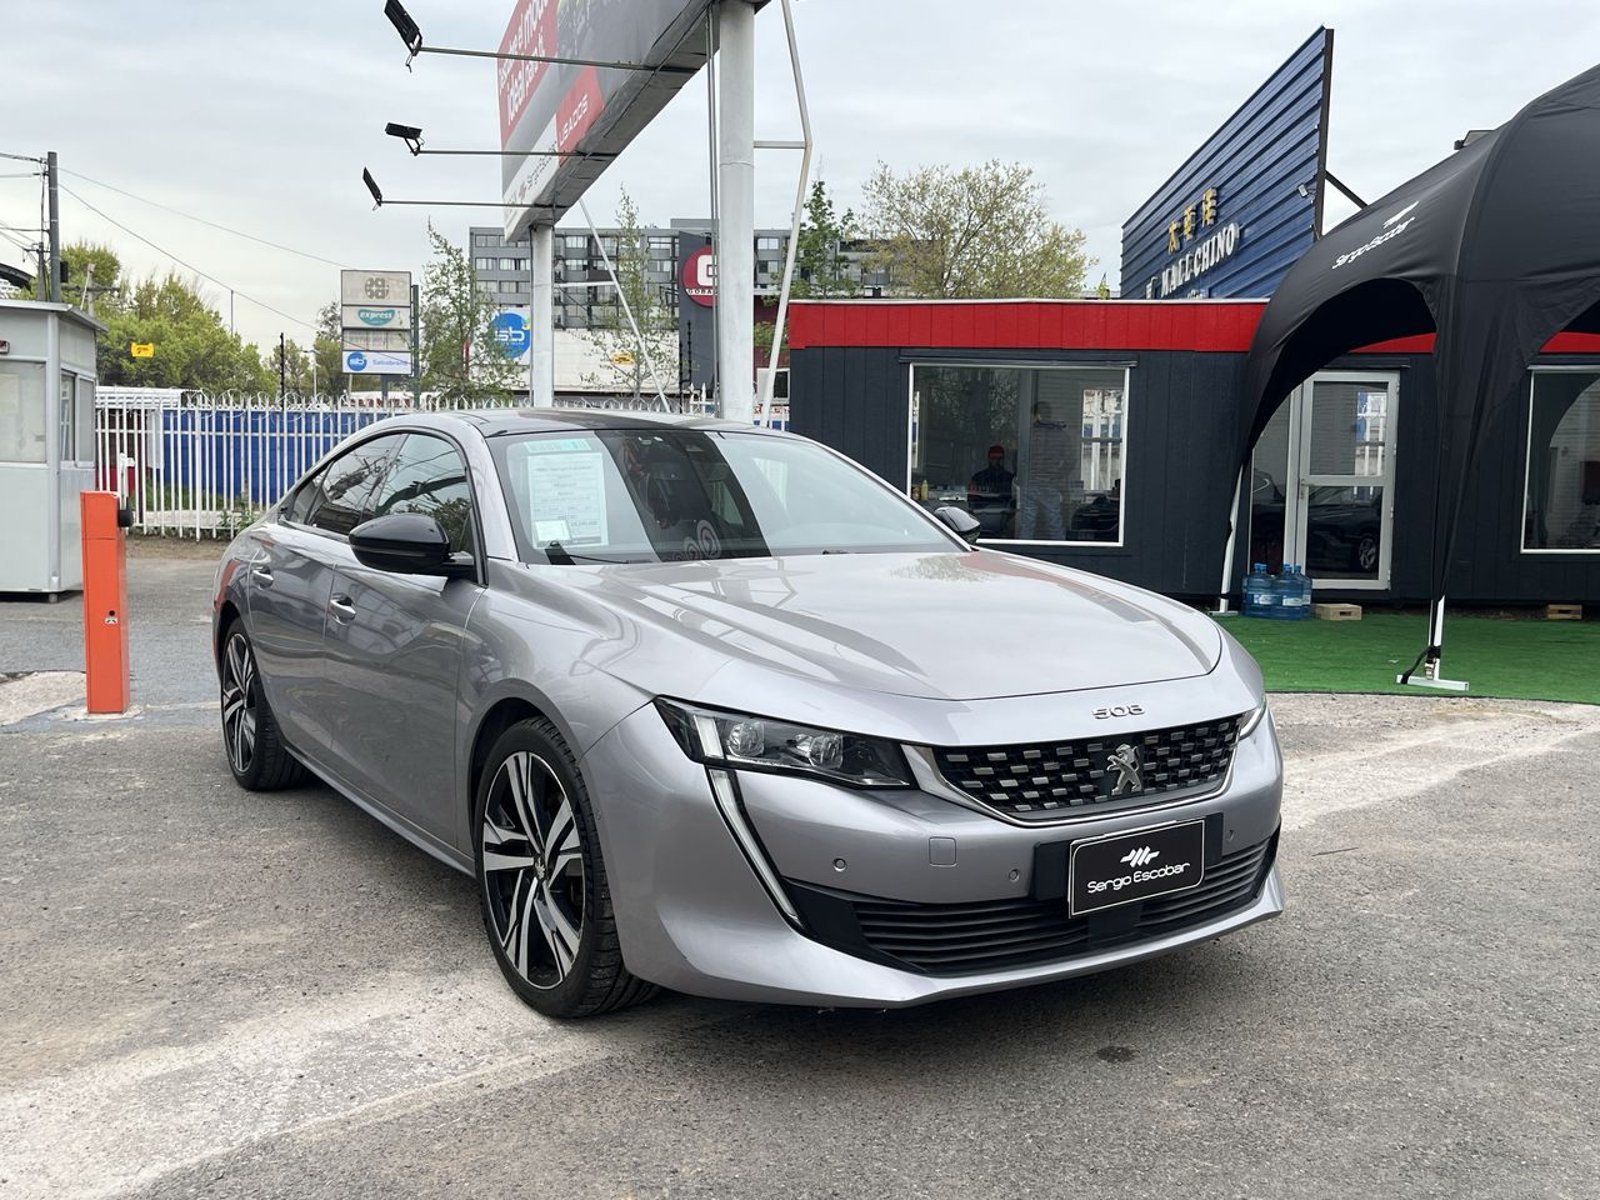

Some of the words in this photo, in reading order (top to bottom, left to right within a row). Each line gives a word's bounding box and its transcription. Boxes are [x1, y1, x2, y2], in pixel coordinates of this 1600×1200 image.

[1194, 222, 1239, 278] CHINO
[360, 311, 393, 320] express
[1091, 704, 1145, 720] 508
[1133, 862, 1191, 883] Escobar
